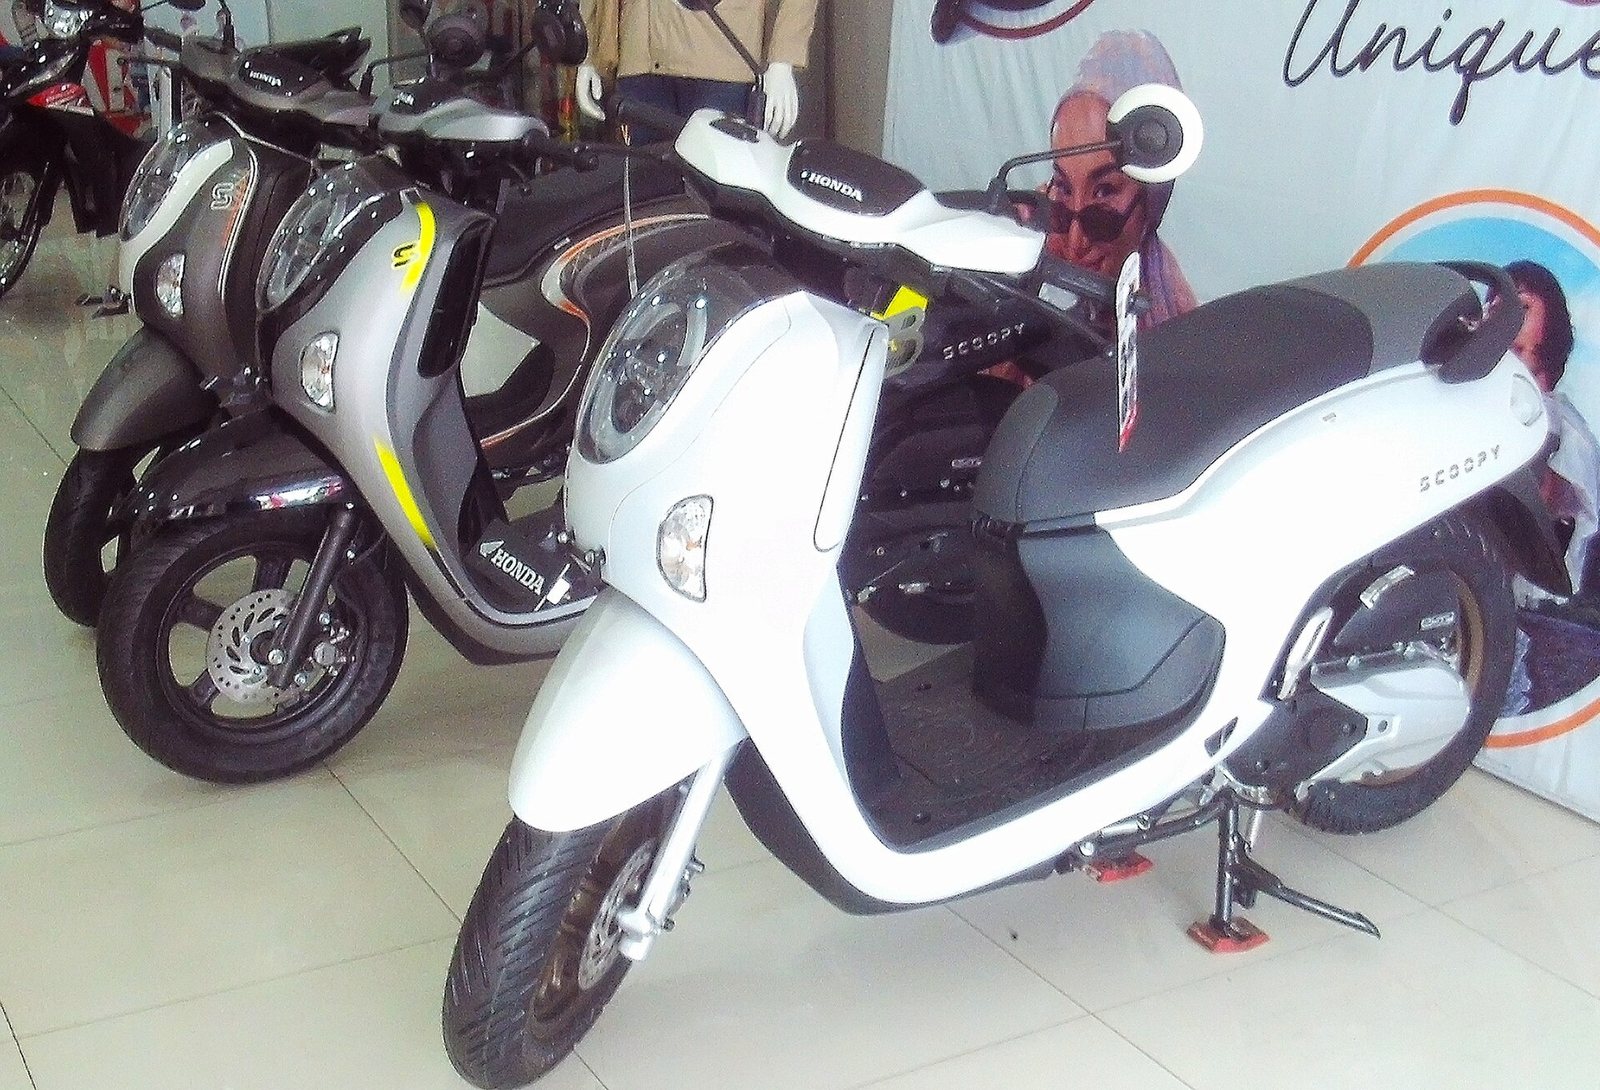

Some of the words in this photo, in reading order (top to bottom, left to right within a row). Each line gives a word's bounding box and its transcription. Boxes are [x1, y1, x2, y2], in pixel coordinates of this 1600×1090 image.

[1283, 0, 1600, 126] Unique
[808, 172, 863, 202] HONDA
[942, 322, 1025, 360] SCOOPY
[1420, 444, 1500, 492] SCOOPY
[490, 547, 545, 596] HONDA
